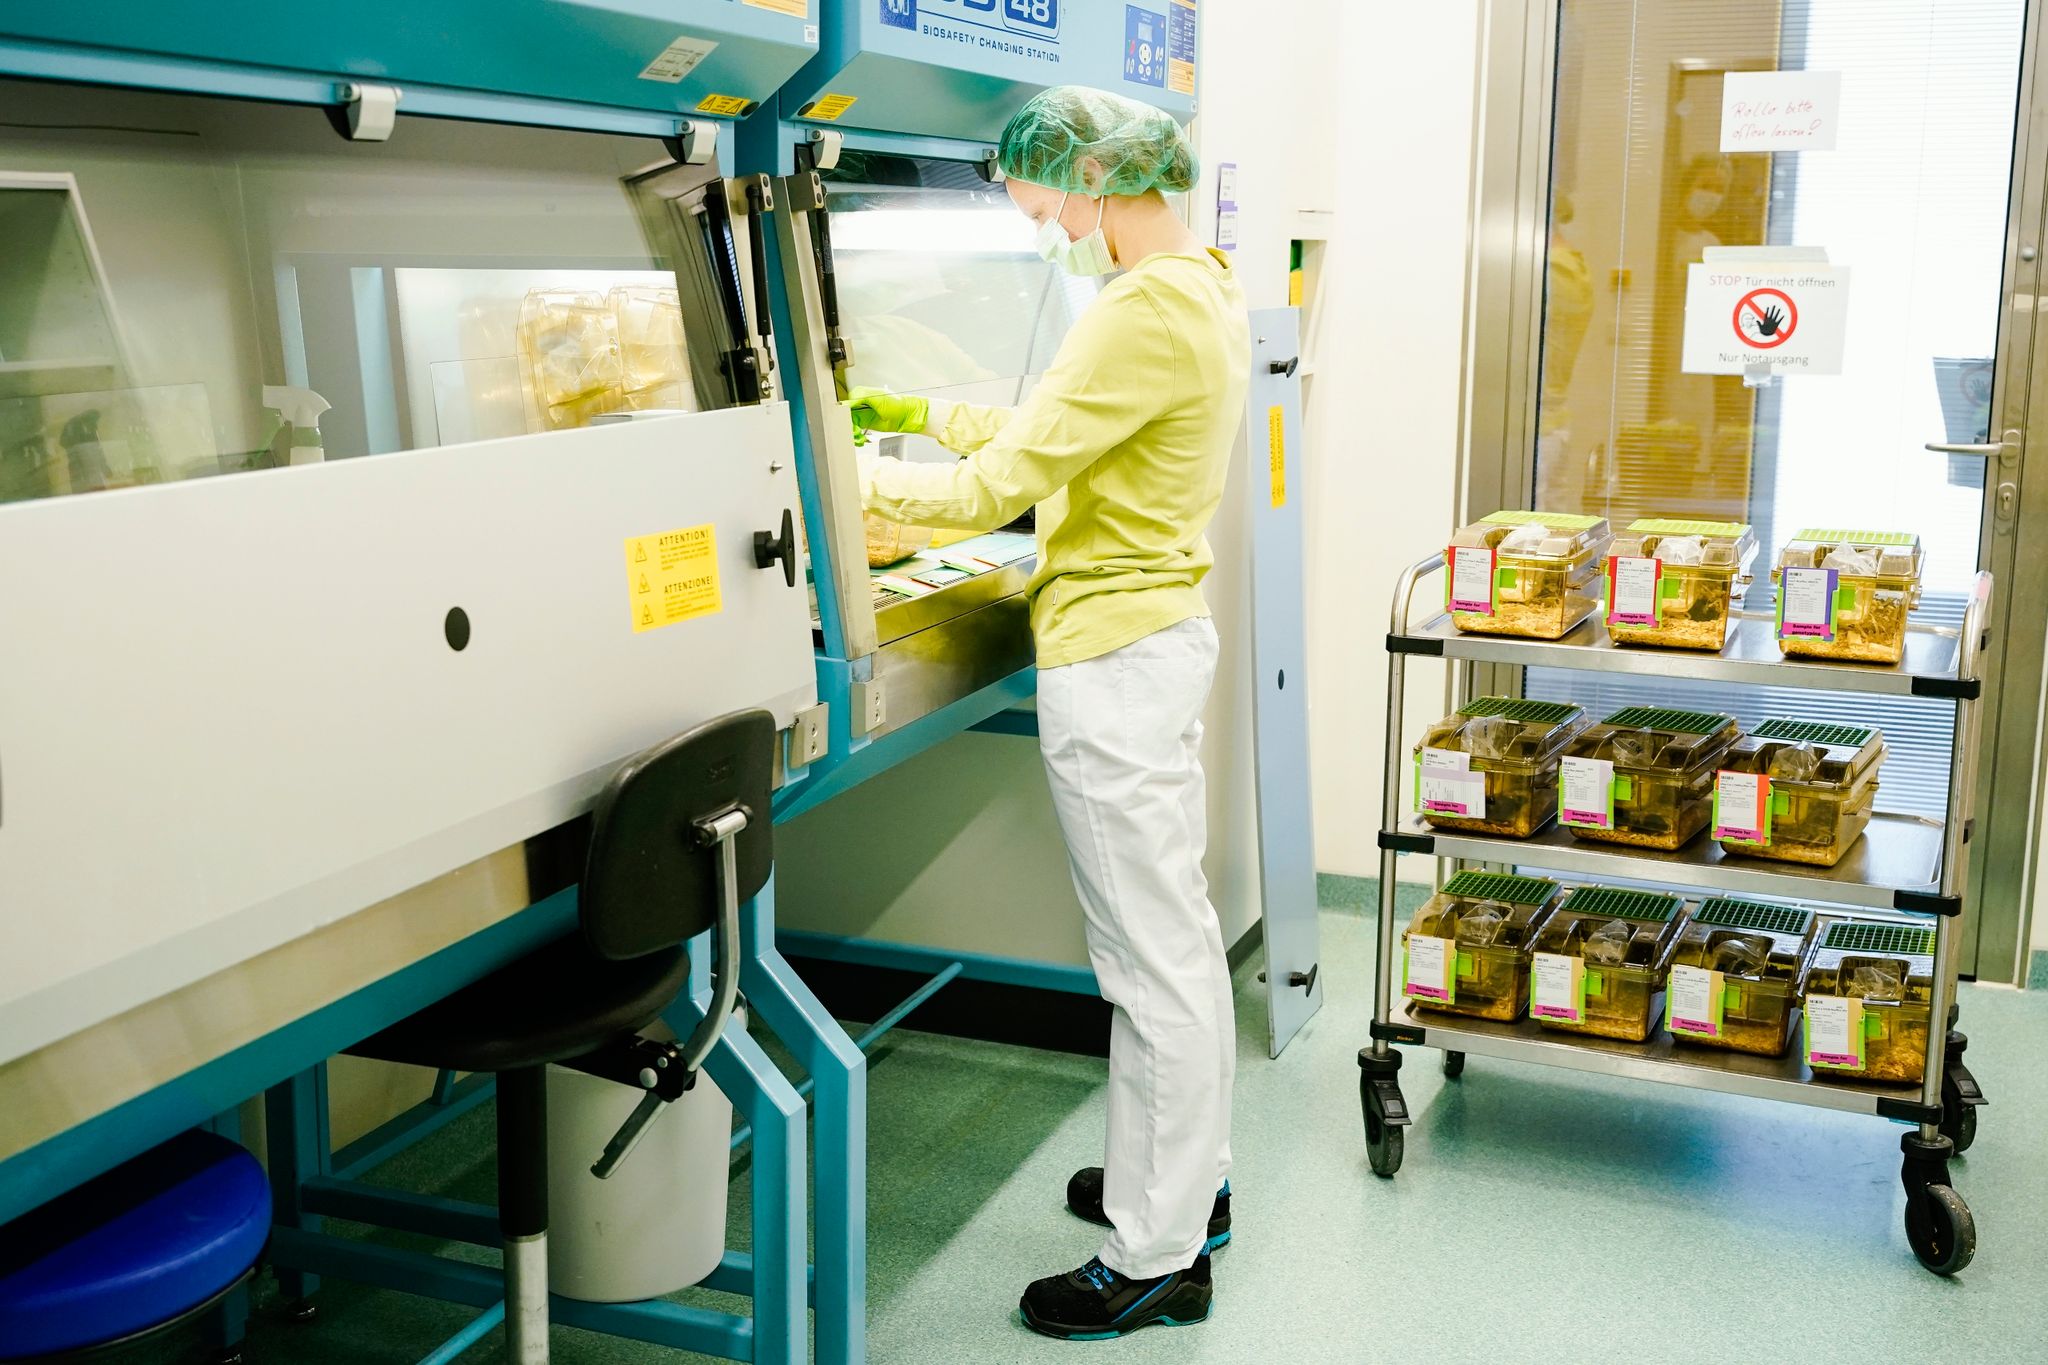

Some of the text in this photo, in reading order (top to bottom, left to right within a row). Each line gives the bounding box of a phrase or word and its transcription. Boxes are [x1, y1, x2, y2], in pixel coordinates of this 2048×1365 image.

[923, 24, 1060, 63] BIOSAFETY CHANGING STATION
[1785, 100, 1814, 114] bitte
[1709, 275, 1742, 286] STOP
[1766, 276, 1794, 287] nicht
[1718, 353, 1809, 366] Nur Notausgang
[659, 528, 709, 546] ATTENTION!
[664, 575, 713, 594] ATTENZIONE!
